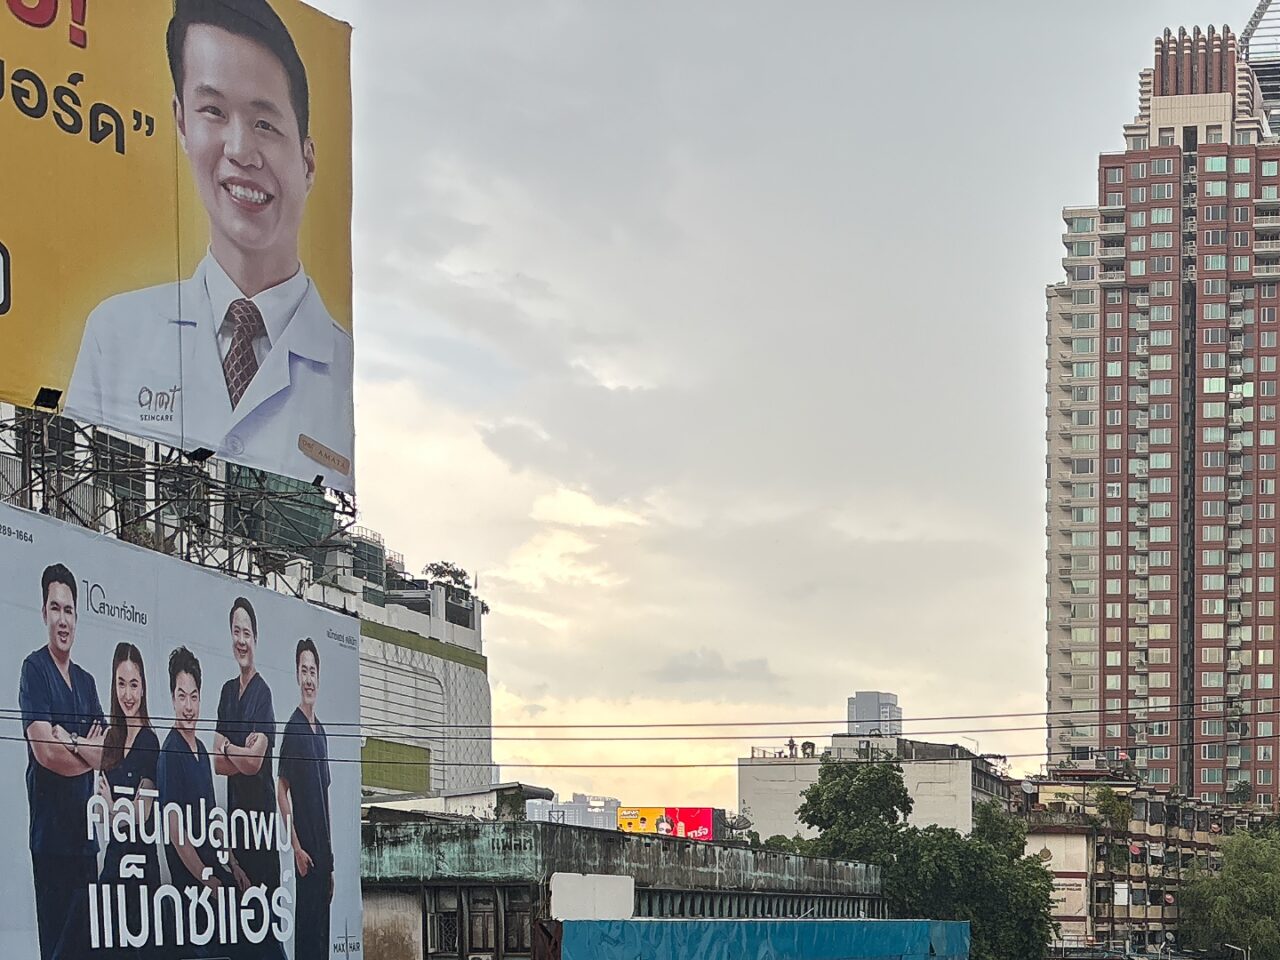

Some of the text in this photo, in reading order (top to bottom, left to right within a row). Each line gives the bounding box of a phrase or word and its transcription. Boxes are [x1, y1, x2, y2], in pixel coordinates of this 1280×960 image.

[0, 59, 155, 156] อร์ด”
[139, 414, 174, 422] SKINCARE
[88, 854, 294, 949] แม็กซ์แฮร์
